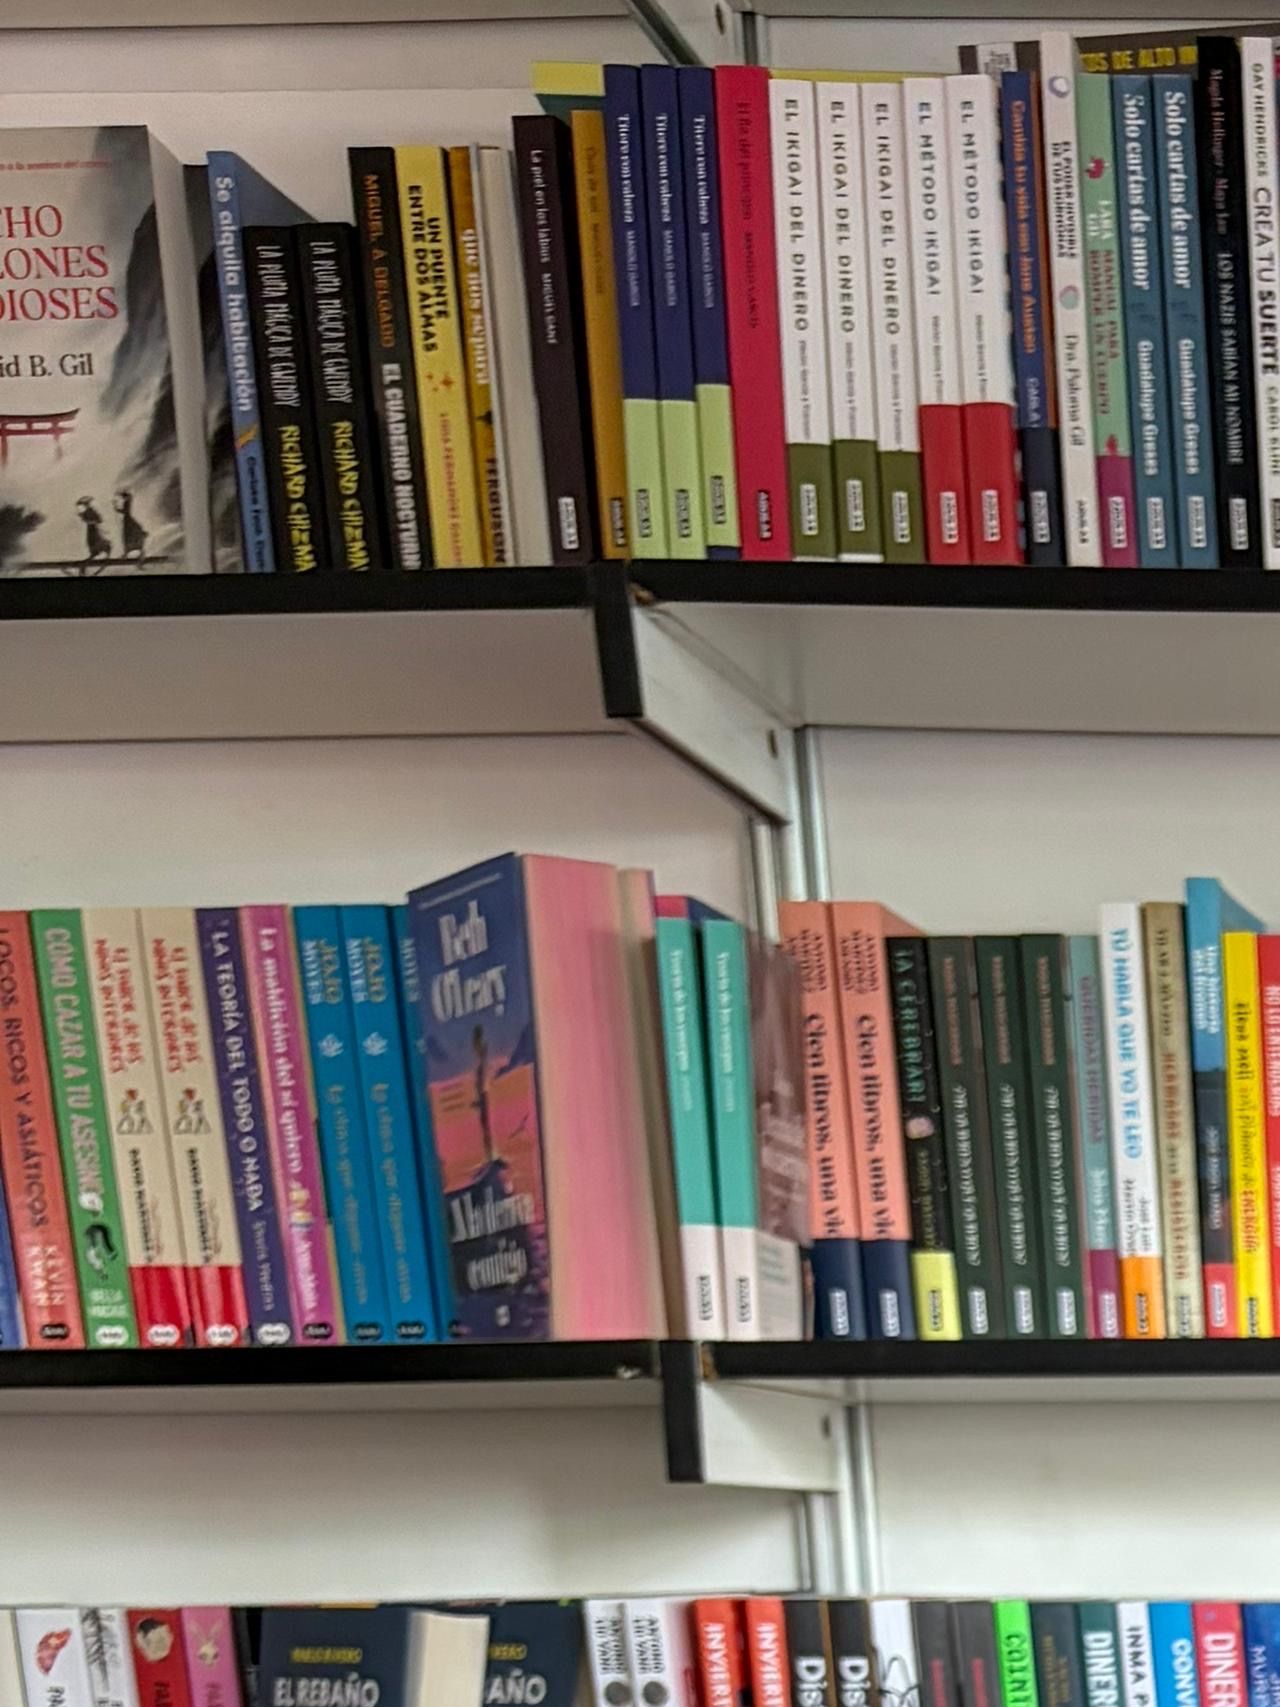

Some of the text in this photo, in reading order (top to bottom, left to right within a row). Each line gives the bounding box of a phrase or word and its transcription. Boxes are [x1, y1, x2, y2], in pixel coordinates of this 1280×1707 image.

[785, 99, 809, 332] EL IKIGAI DEL DINERO
[1252, 187, 1280, 376] CREA TU SUERTE
[275, 1678, 295, 1707] EL
